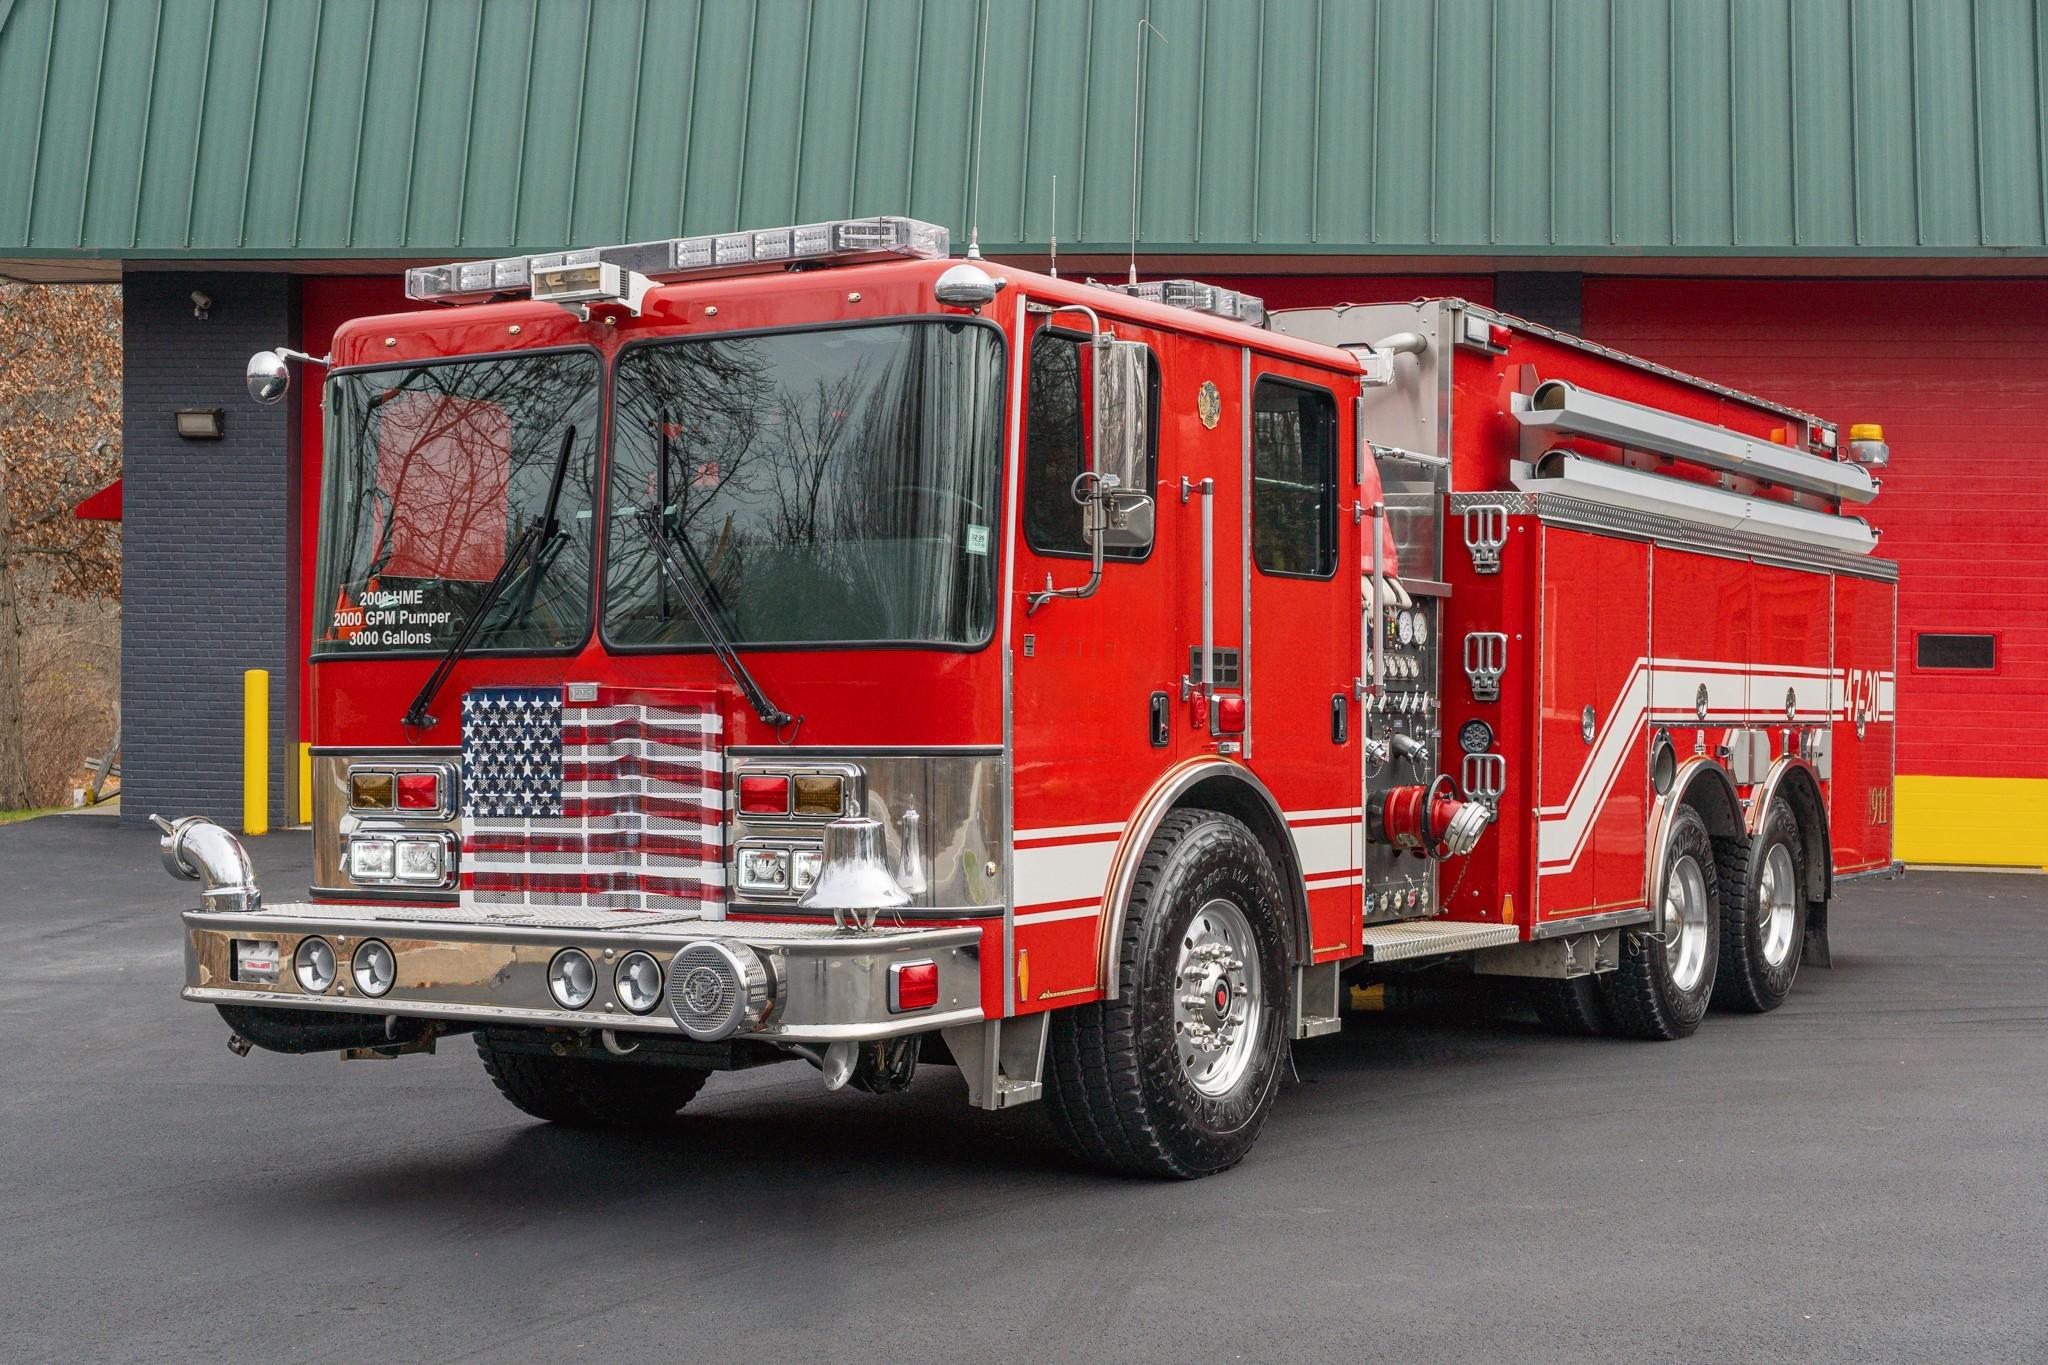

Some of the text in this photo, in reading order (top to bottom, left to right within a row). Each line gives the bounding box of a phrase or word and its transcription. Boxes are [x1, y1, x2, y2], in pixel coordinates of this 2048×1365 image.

[393, 590, 423, 604] HME
[333, 610, 451, 627] 2000 GPM Pumper
[349, 630, 432, 646] 3000 Gallons
[1844, 668, 1880, 723] 47-20
[1871, 786, 1888, 825] 911
